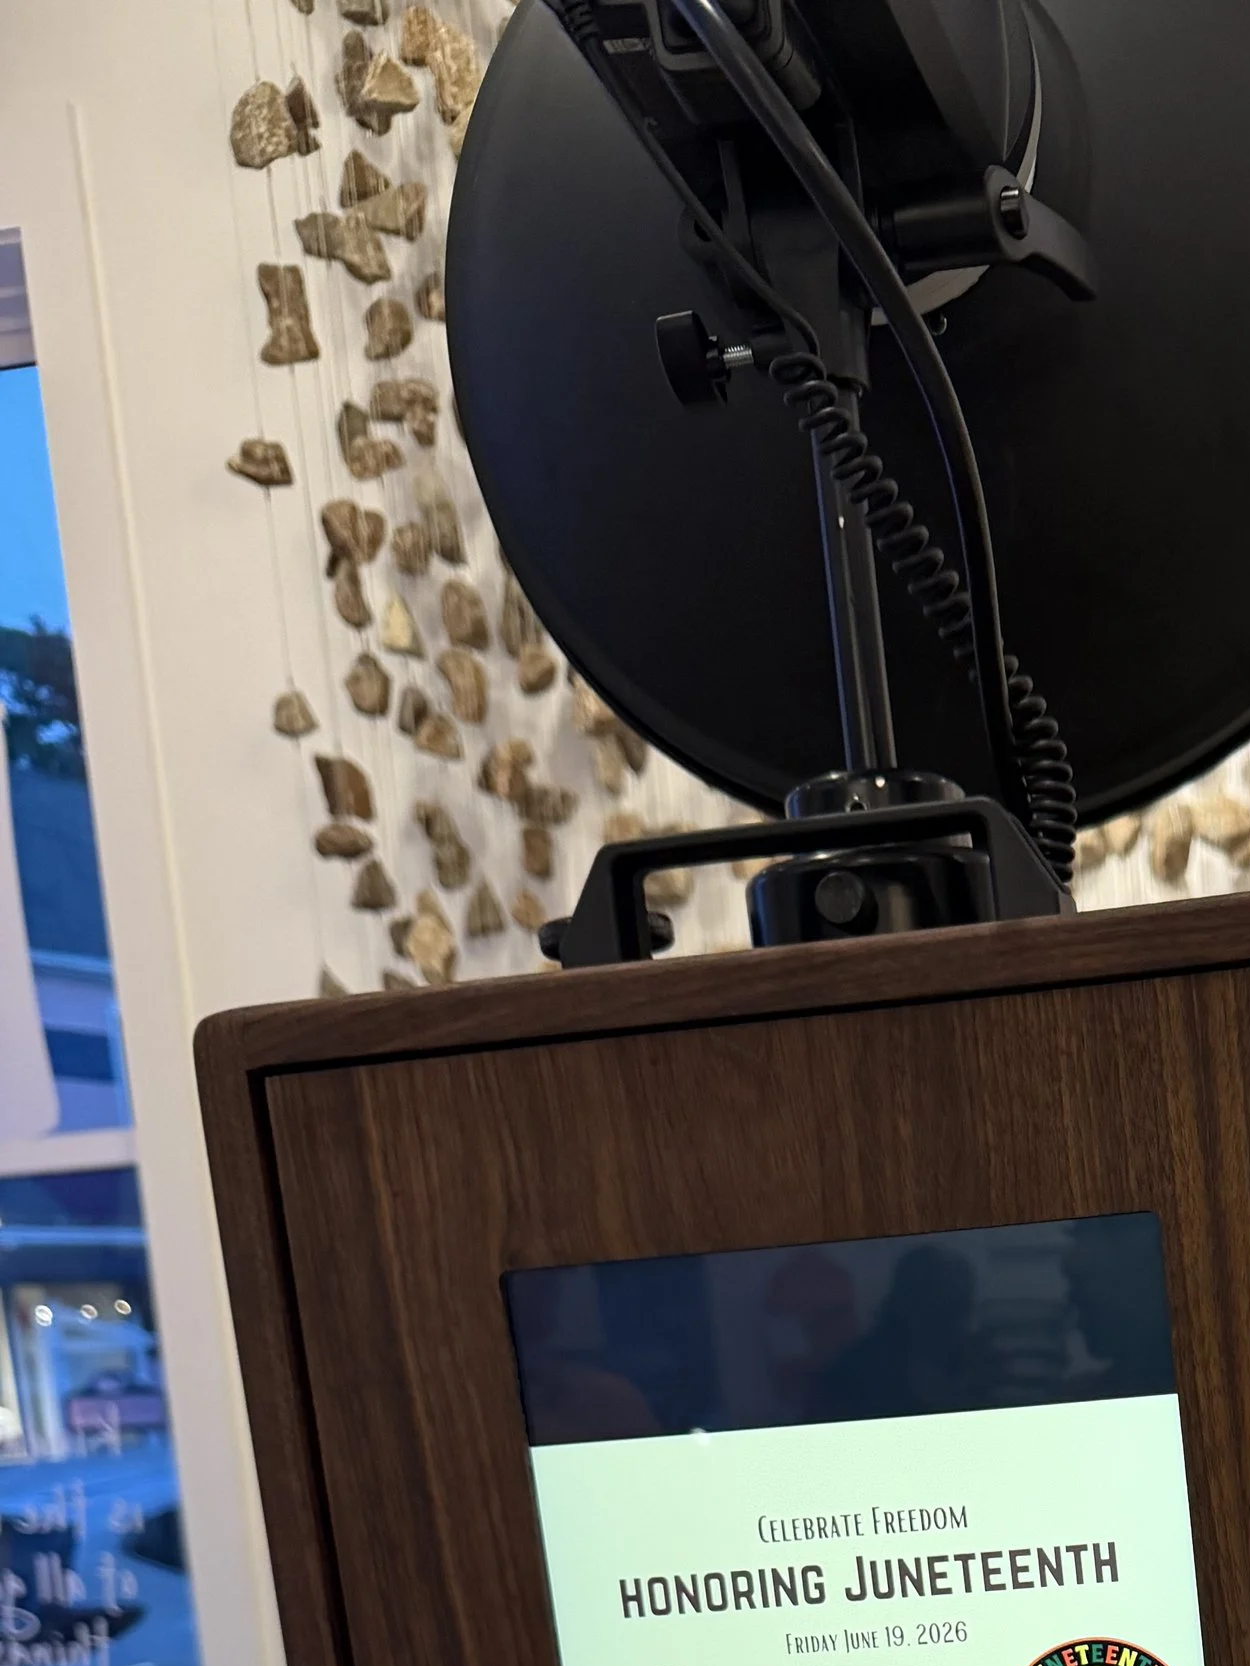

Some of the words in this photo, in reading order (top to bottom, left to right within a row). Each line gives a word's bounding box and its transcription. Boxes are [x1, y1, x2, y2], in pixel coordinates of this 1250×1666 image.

[757, 1513, 865, 1544] CELEBRATE
[871, 1505, 969, 1535] FREEDOM
[618, 1564, 827, 1618] HONORING
[844, 1542, 1119, 1602] JUNETEENTH
[784, 1633, 838, 1655] FRIDAY
[843, 1628, 880, 1653] JUNE
[916, 1620, 968, 1646] 2026
